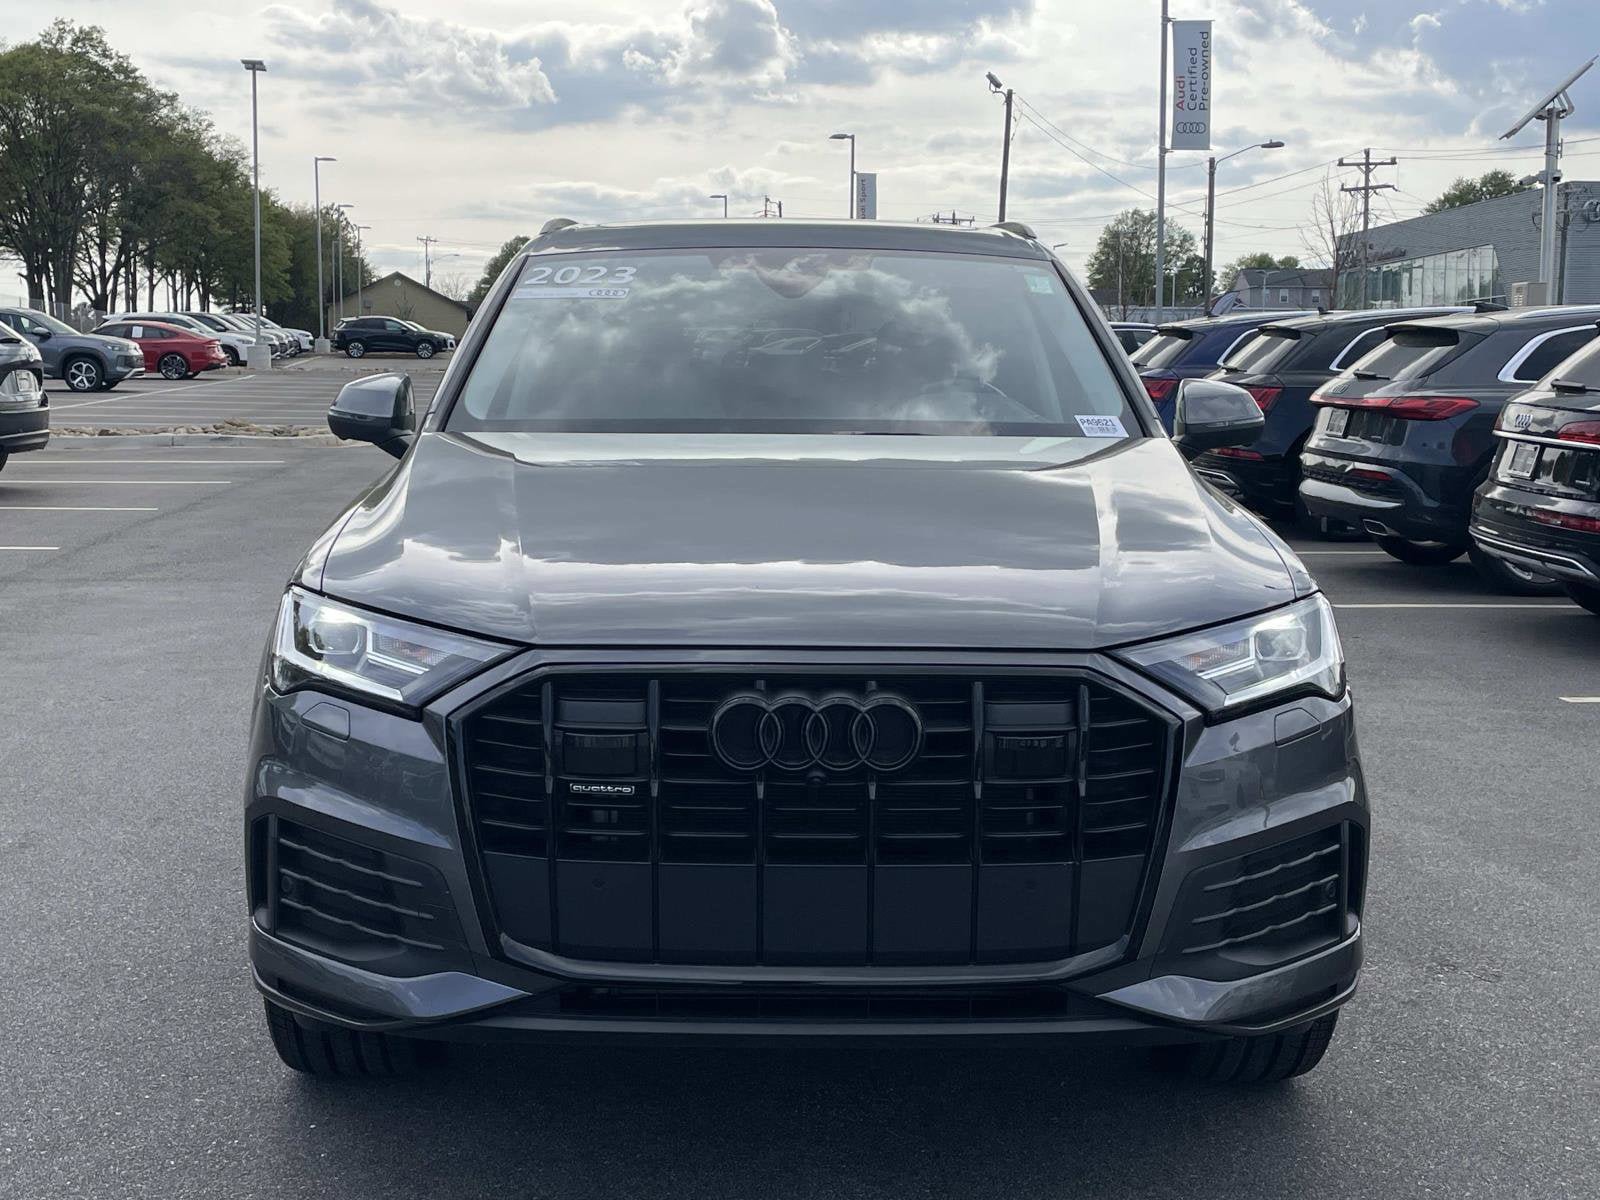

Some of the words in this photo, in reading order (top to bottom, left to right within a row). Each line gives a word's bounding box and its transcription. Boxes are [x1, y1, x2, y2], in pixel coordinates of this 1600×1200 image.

[1187, 47, 1197, 111] Certified
[1199, 31, 1209, 111] Pre-owned
[1176, 76, 1185, 111] Audi
[524, 266, 637, 285] 2023
[571, 784, 633, 793] quattro
